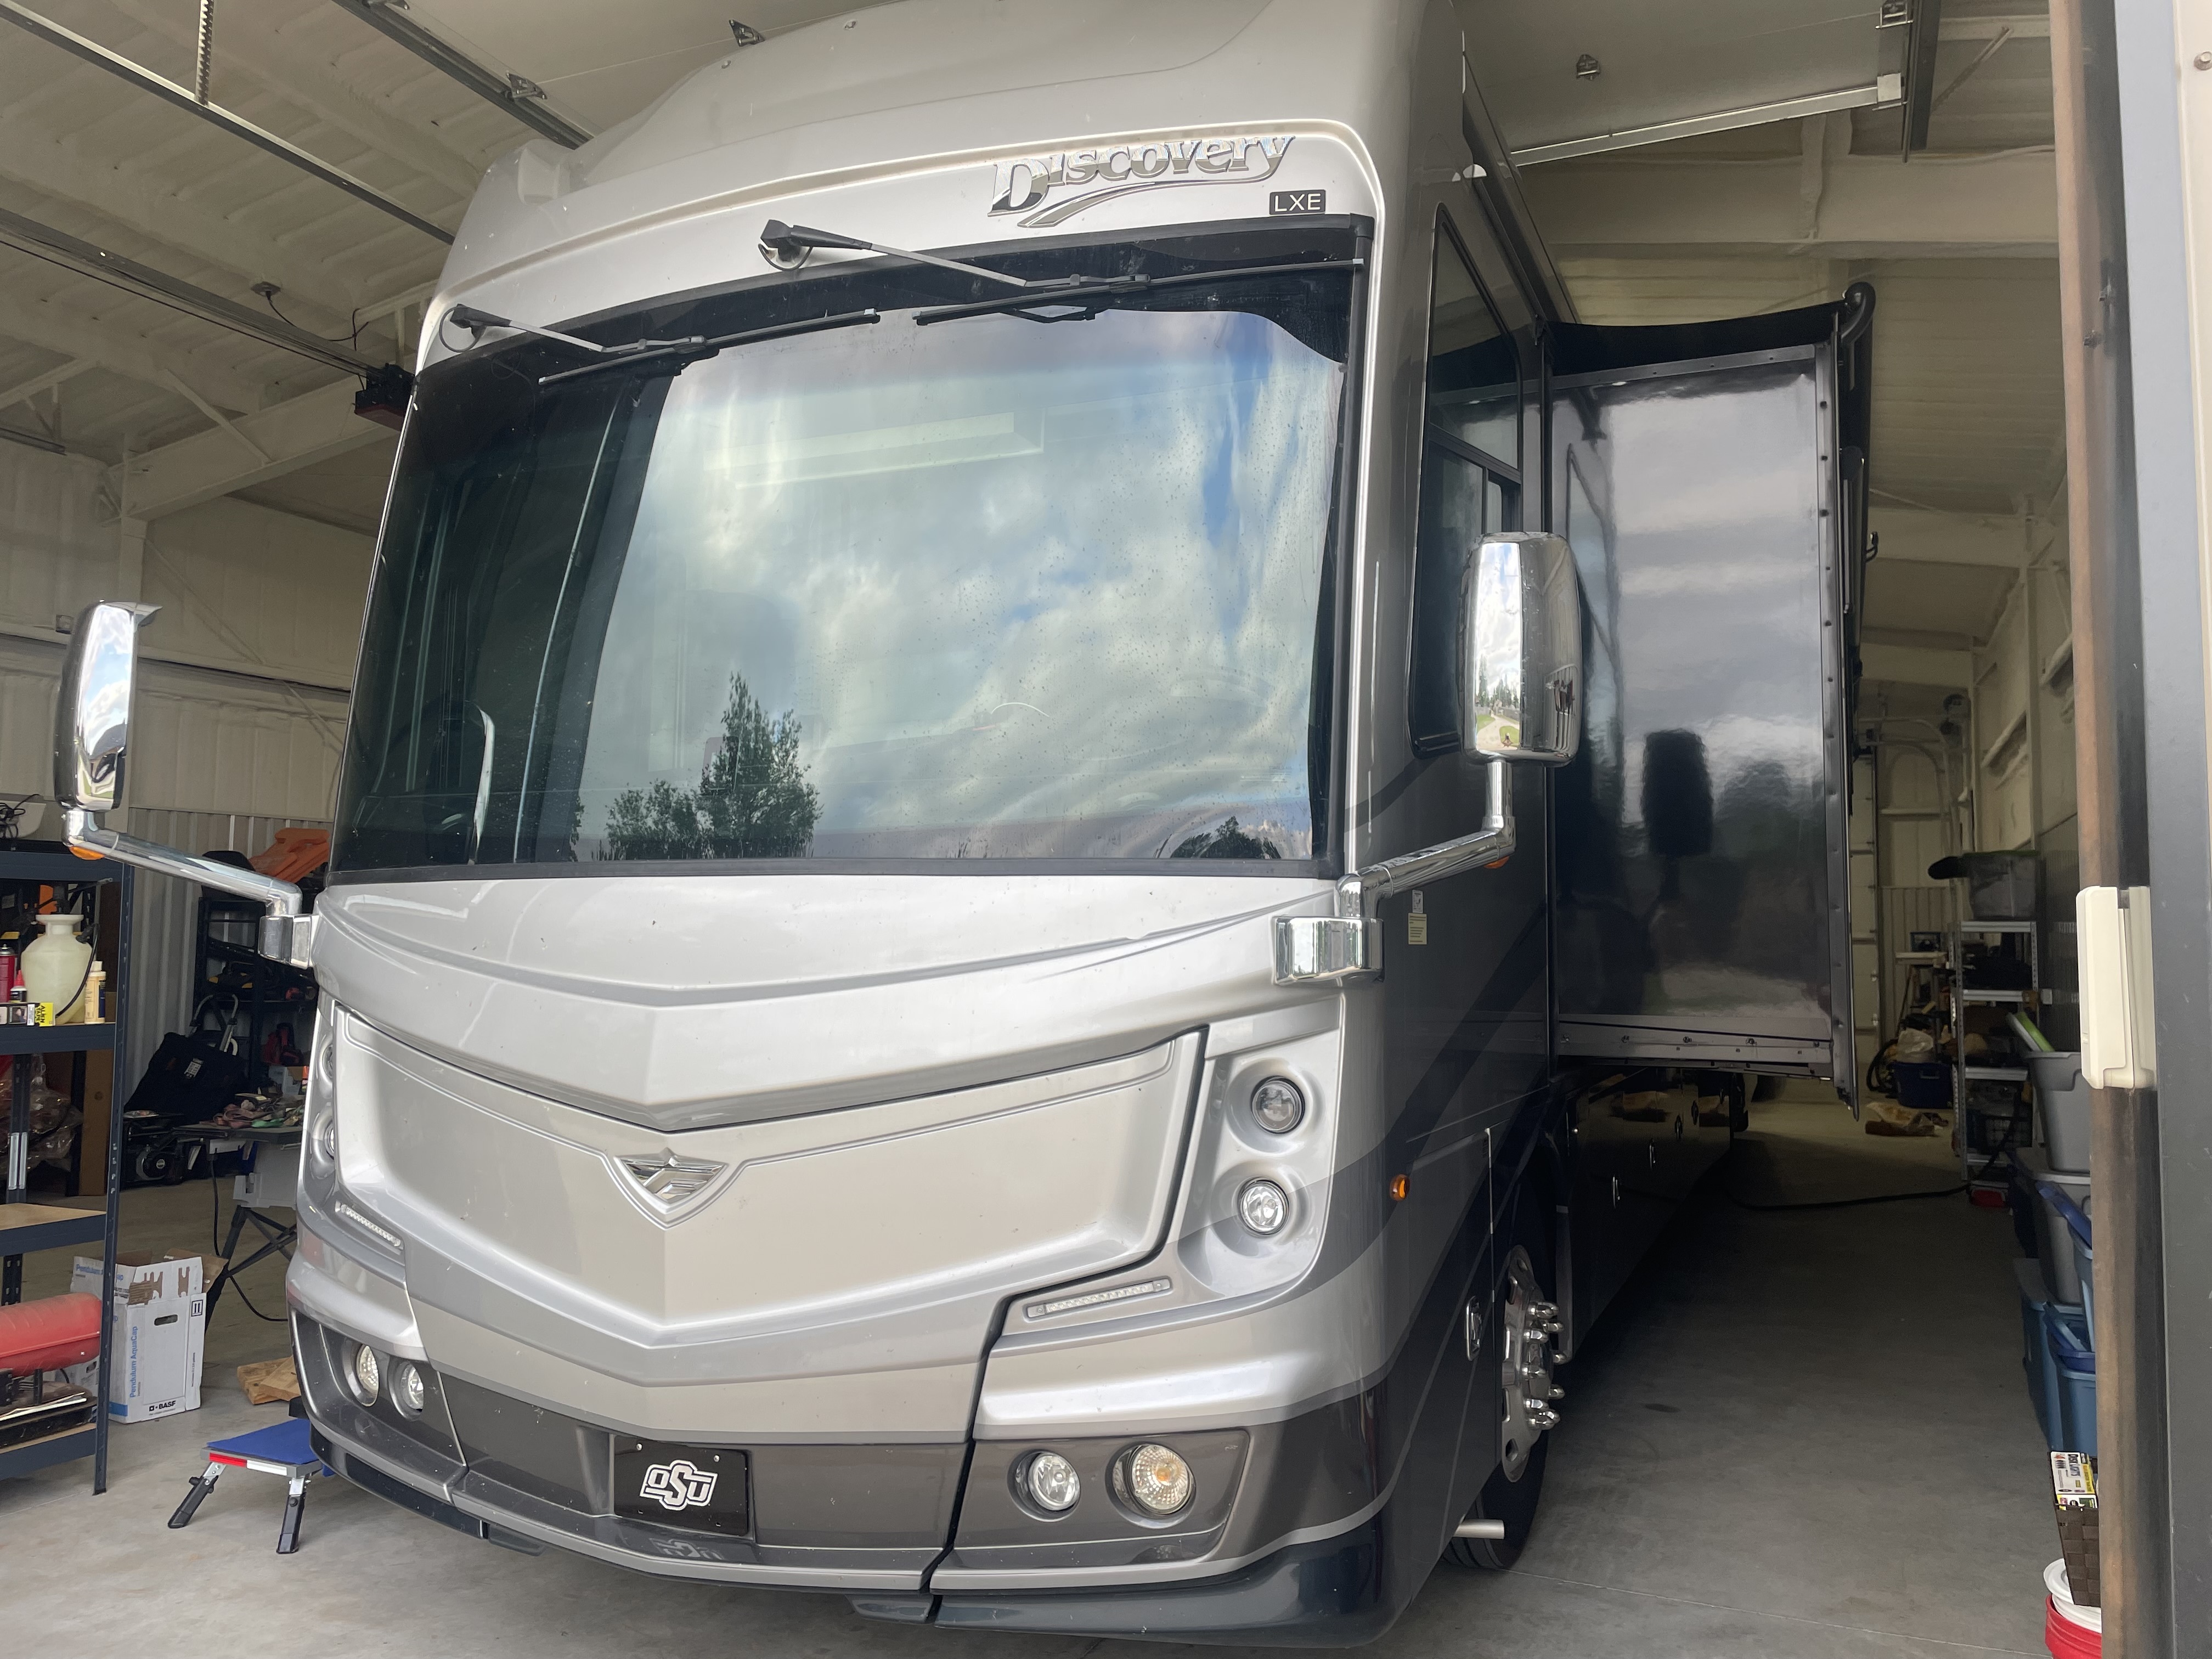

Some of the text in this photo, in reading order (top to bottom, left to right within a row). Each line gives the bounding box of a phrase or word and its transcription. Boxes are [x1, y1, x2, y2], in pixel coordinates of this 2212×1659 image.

[988, 136, 1295, 218] Discovery
[1274, 194, 1321, 212] LXE
[159, 1400, 176, 1409] BASF
[640, 1460, 718, 1510] OSU
